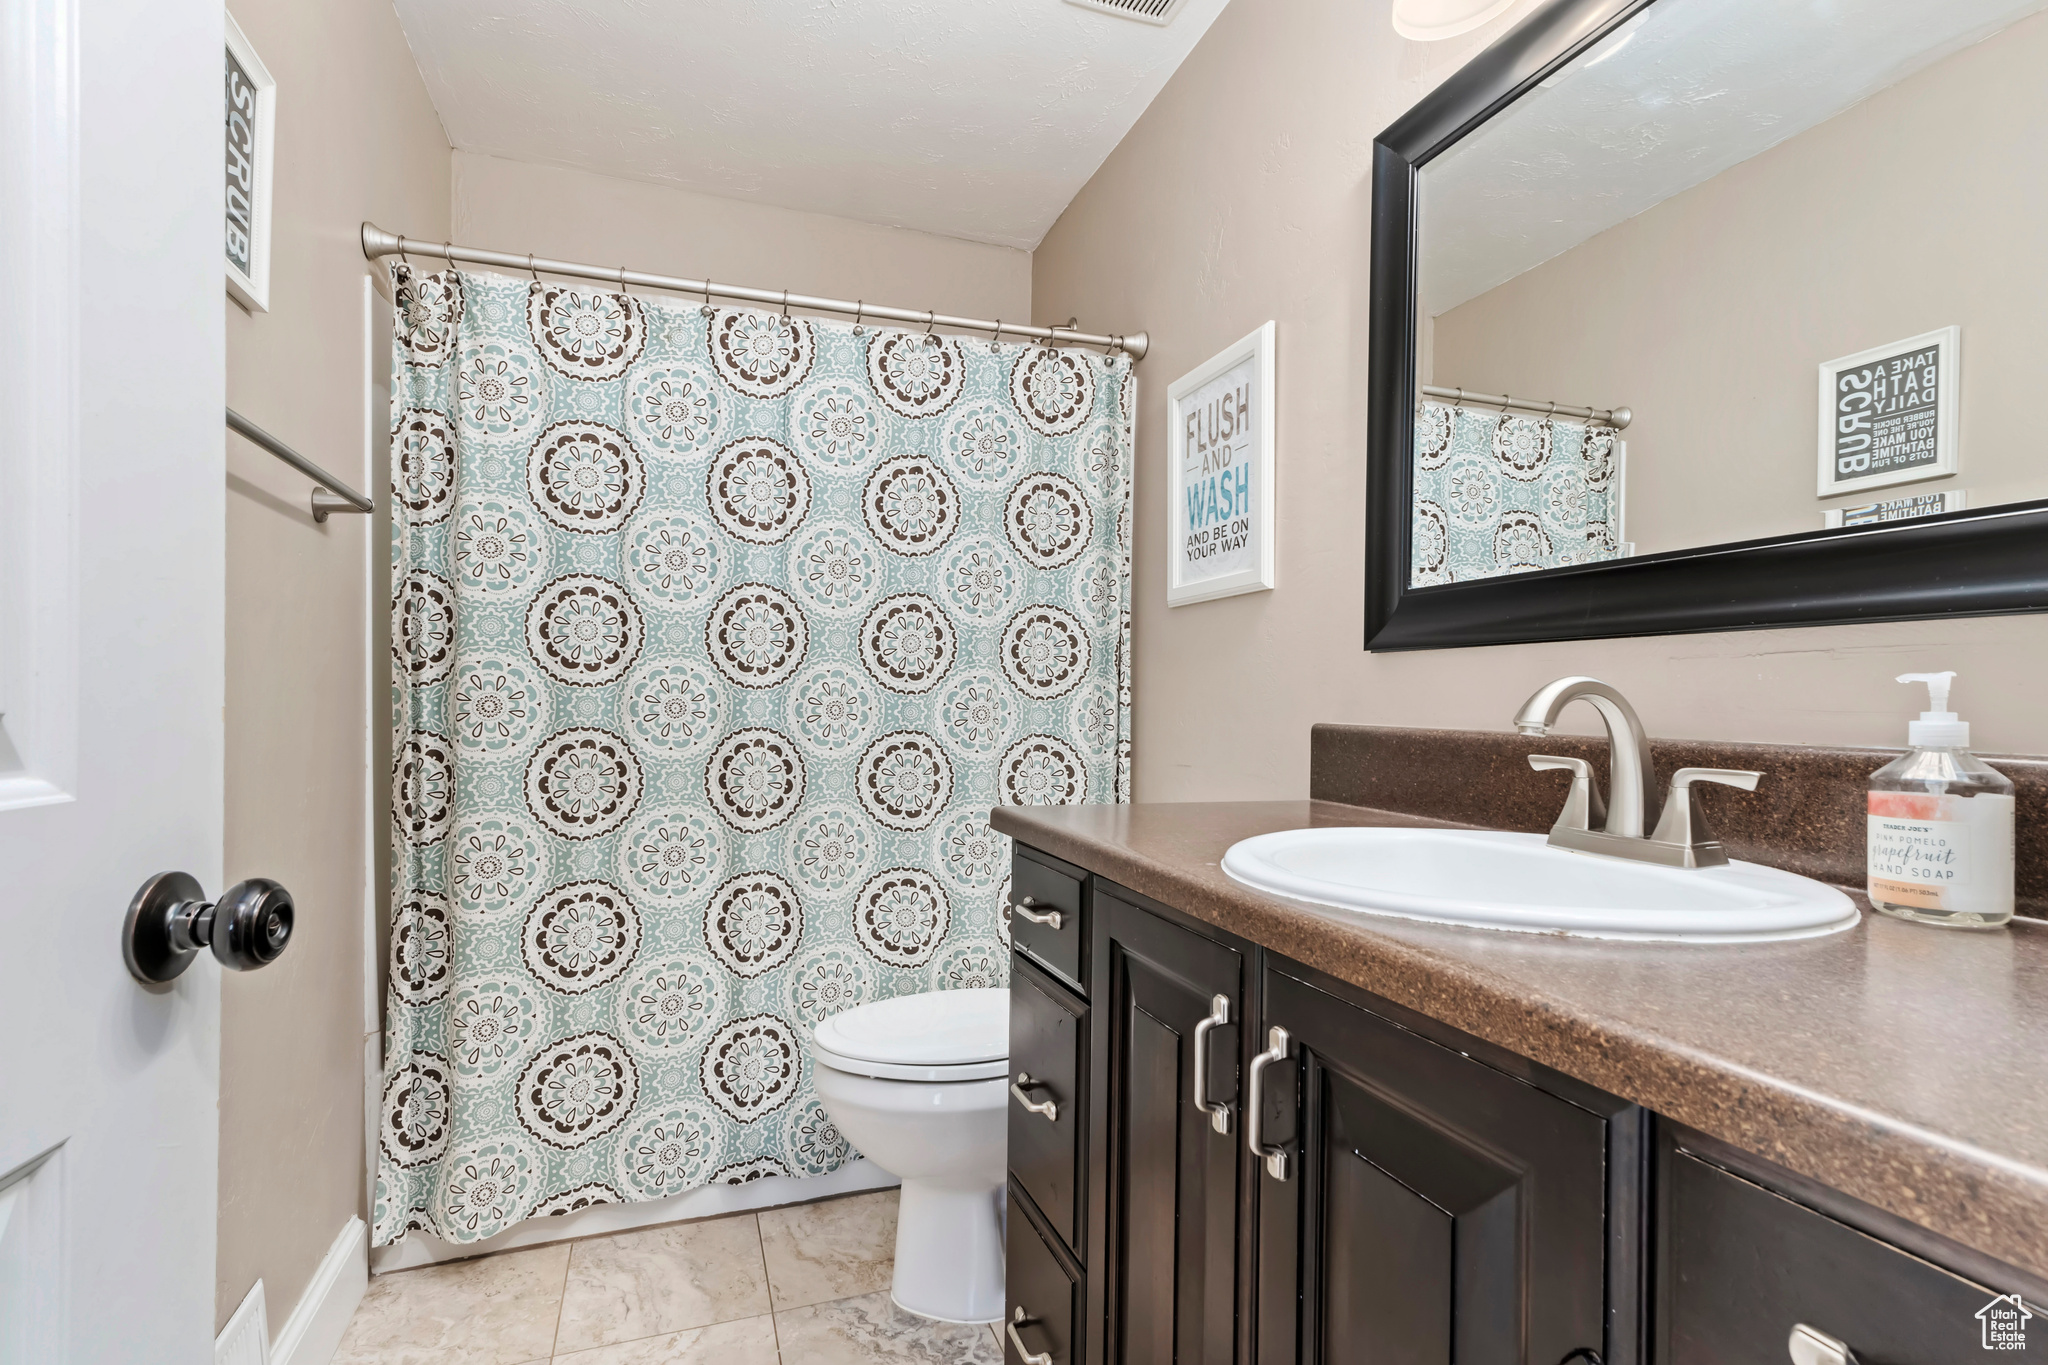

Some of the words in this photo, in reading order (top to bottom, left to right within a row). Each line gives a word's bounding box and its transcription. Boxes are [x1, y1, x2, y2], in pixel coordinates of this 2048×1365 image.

[226, 71, 253, 264] SCRUB
[1186, 383, 1249, 459] FLUSH
[1202, 444, 1232, 477] AND
[1187, 462, 1249, 530] WASH
[1186, 530, 1209, 548] AND
[1213, 525, 1227, 541] BE
[1232, 518, 1249, 534] ON
[1186, 543, 1216, 562] YOUR
[1222, 533, 1248, 553] WAY
[1876, 833, 1893, 842] PINK
[1899, 836, 1946, 847] POMELO
[1883, 823, 1906, 831] TRADER
[1872, 845, 1956, 866] grapefruit
[1873, 863, 1902, 875] HAND
[1911, 867, 1954, 880] SOAP
